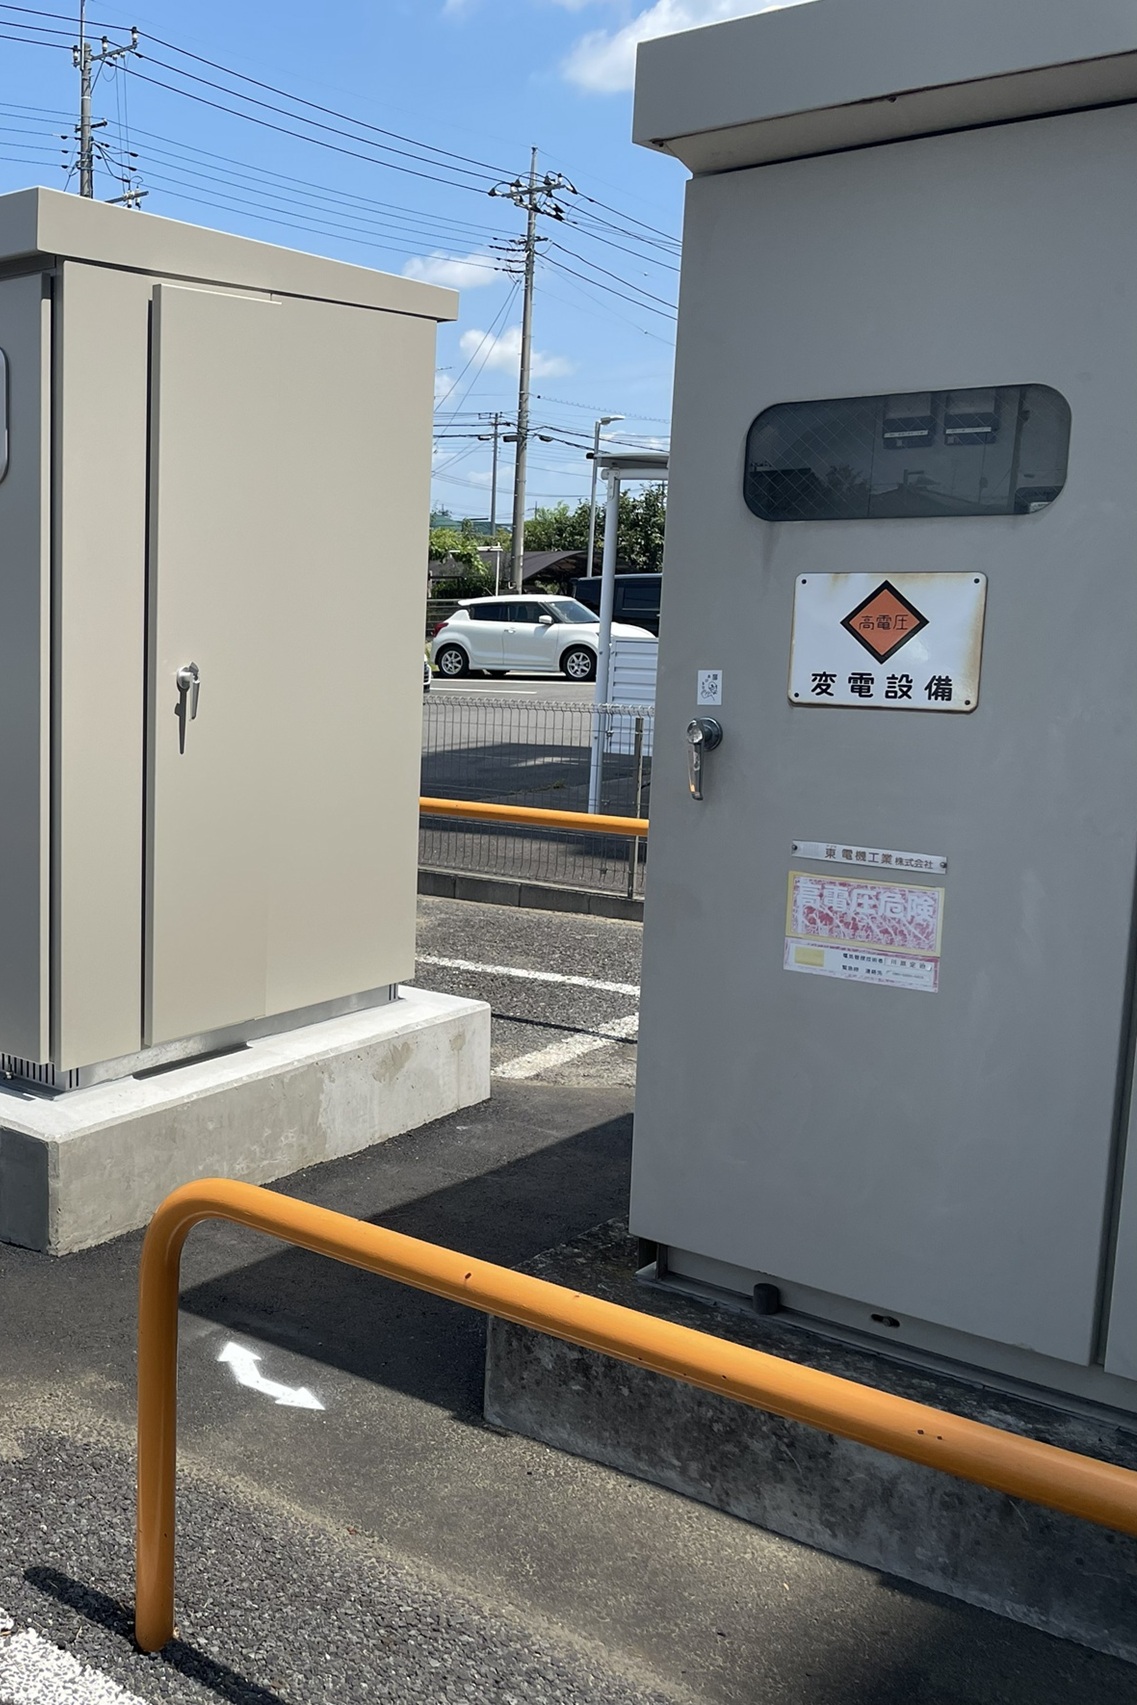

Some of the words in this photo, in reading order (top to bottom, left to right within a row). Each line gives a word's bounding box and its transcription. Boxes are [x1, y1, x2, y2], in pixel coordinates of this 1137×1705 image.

[859, 614, 909, 631] 高電圧
[811, 671, 953, 702] 変電設備
